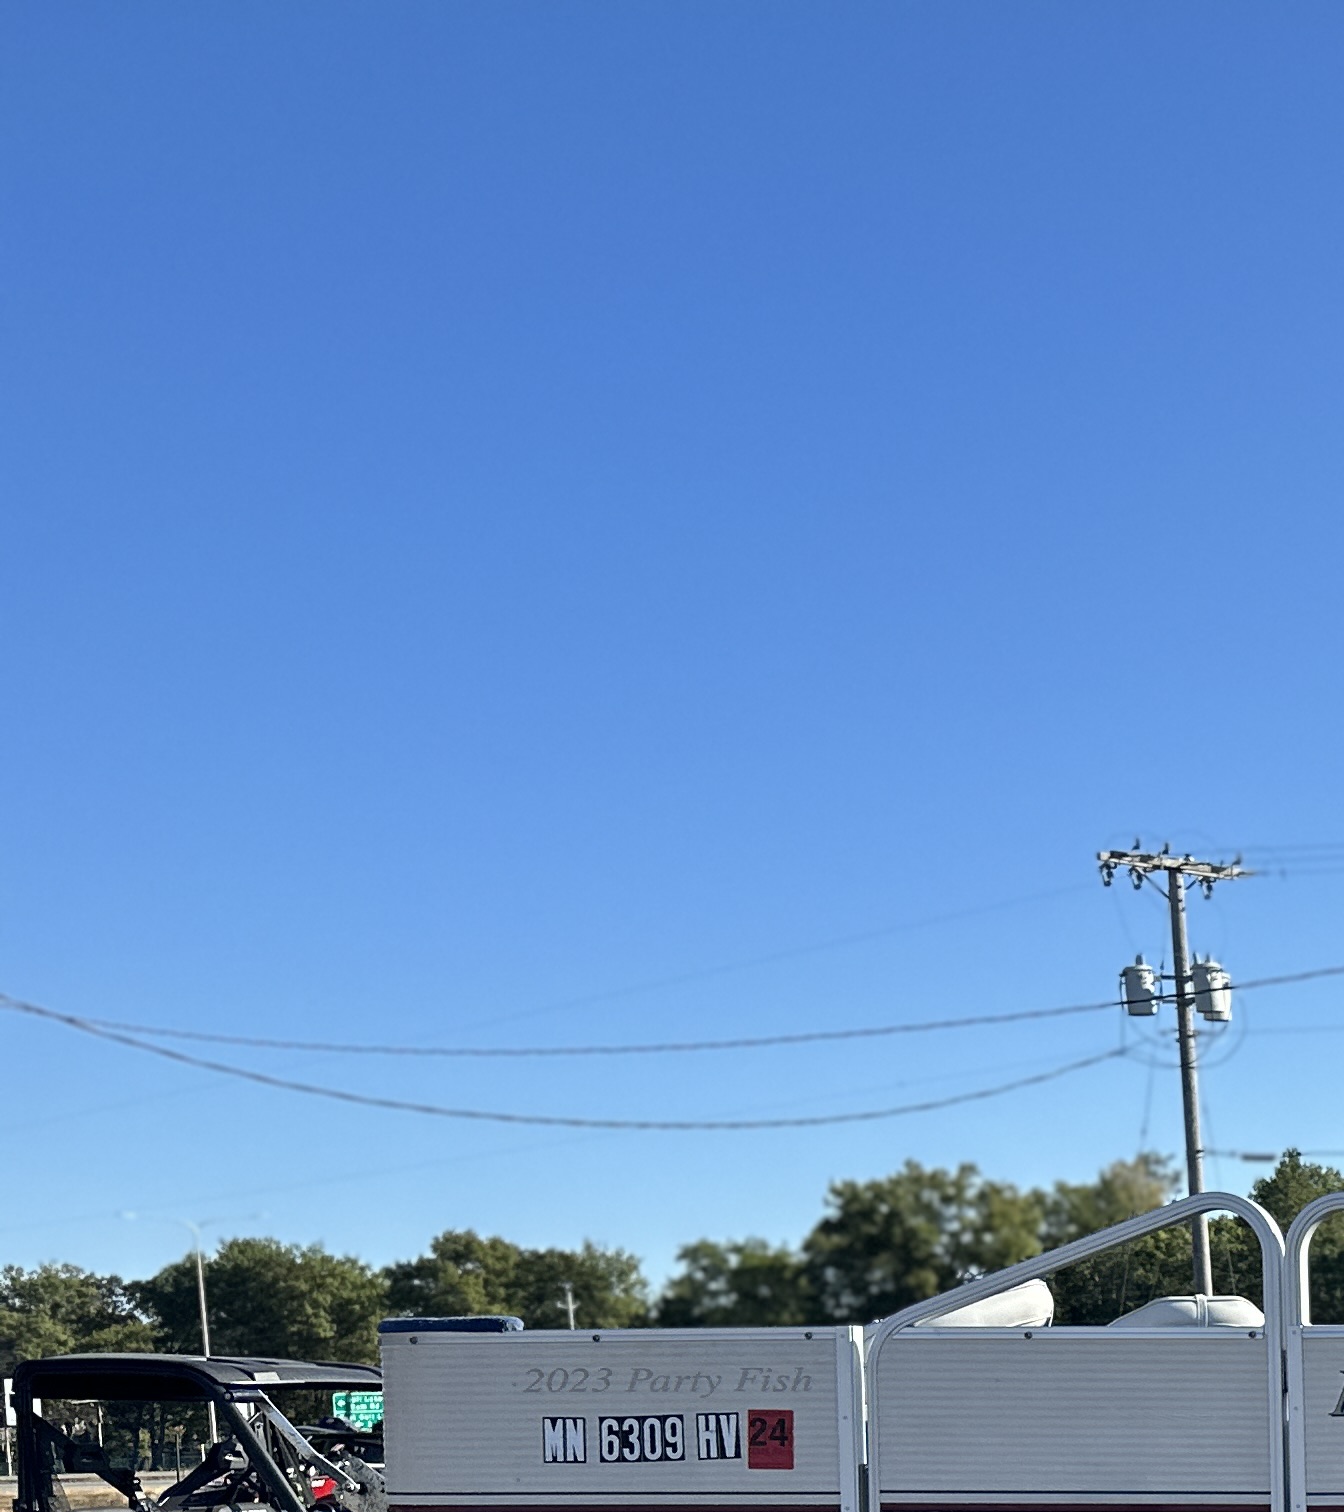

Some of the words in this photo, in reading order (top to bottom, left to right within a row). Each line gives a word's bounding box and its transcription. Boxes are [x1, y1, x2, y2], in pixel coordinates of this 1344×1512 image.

[521, 1367, 613, 1394] 2023
[624, 1366, 723, 1399] Party
[733, 1366, 814, 1393] Fish
[543, 1417, 585, 1462] MN
[601, 1416, 684, 1461] 6309
[698, 1414, 740, 1459] HV
[749, 1416, 789, 1447] 24
